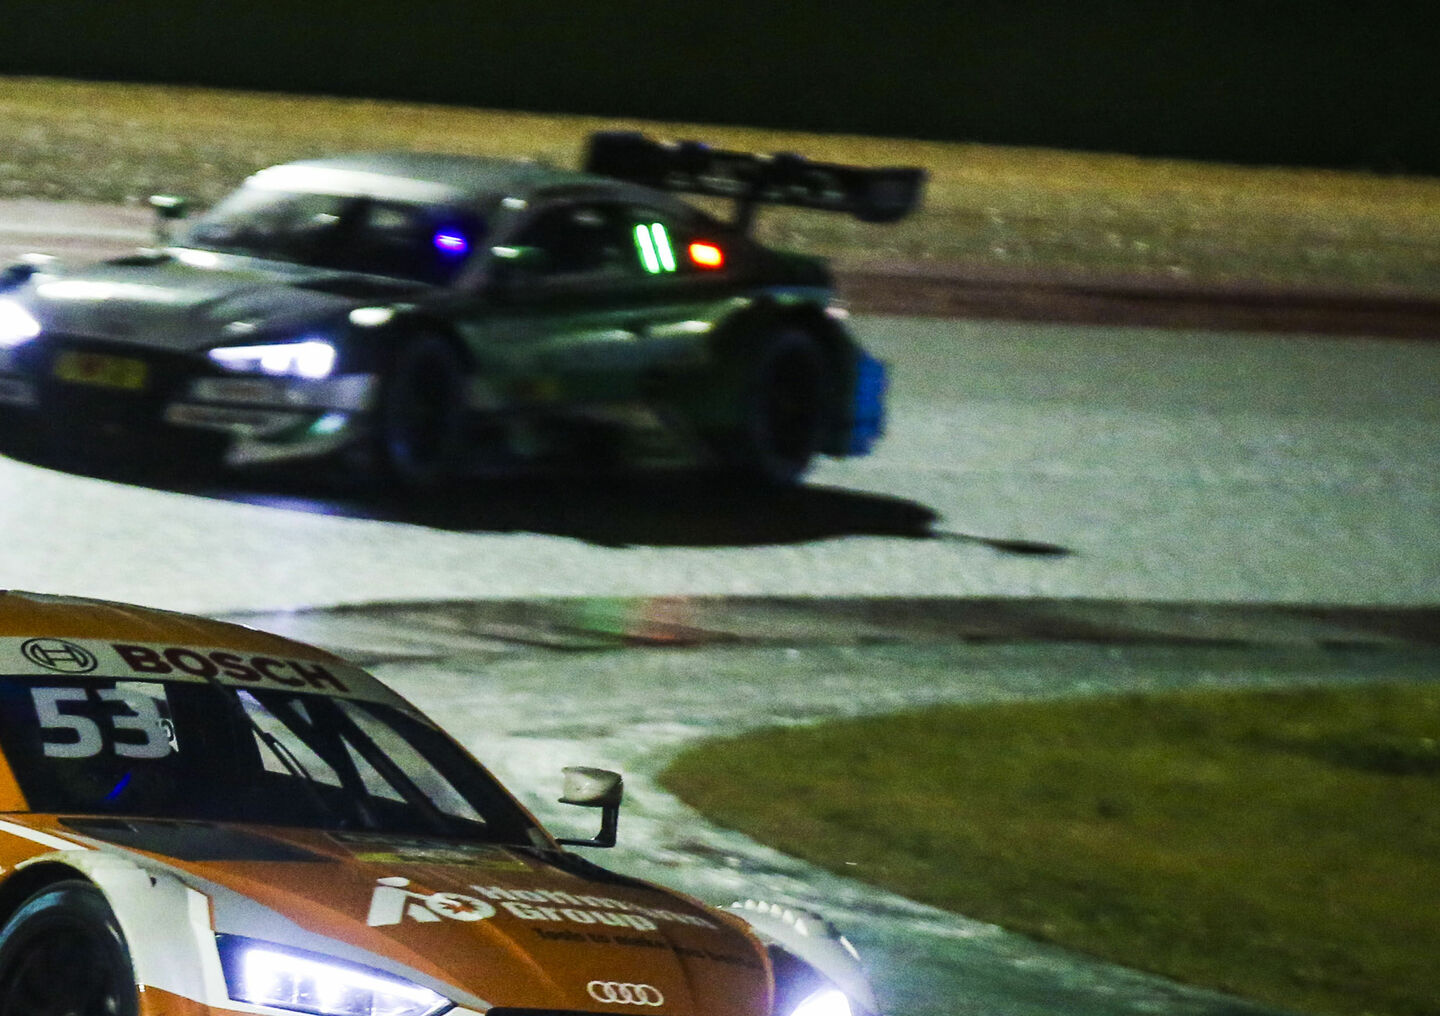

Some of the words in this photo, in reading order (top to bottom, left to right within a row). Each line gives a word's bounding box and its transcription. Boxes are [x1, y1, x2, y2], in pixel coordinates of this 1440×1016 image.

[113, 644, 350, 693] BOSCH
[30, 687, 172, 759] 53
[500, 900, 659, 932] Group
